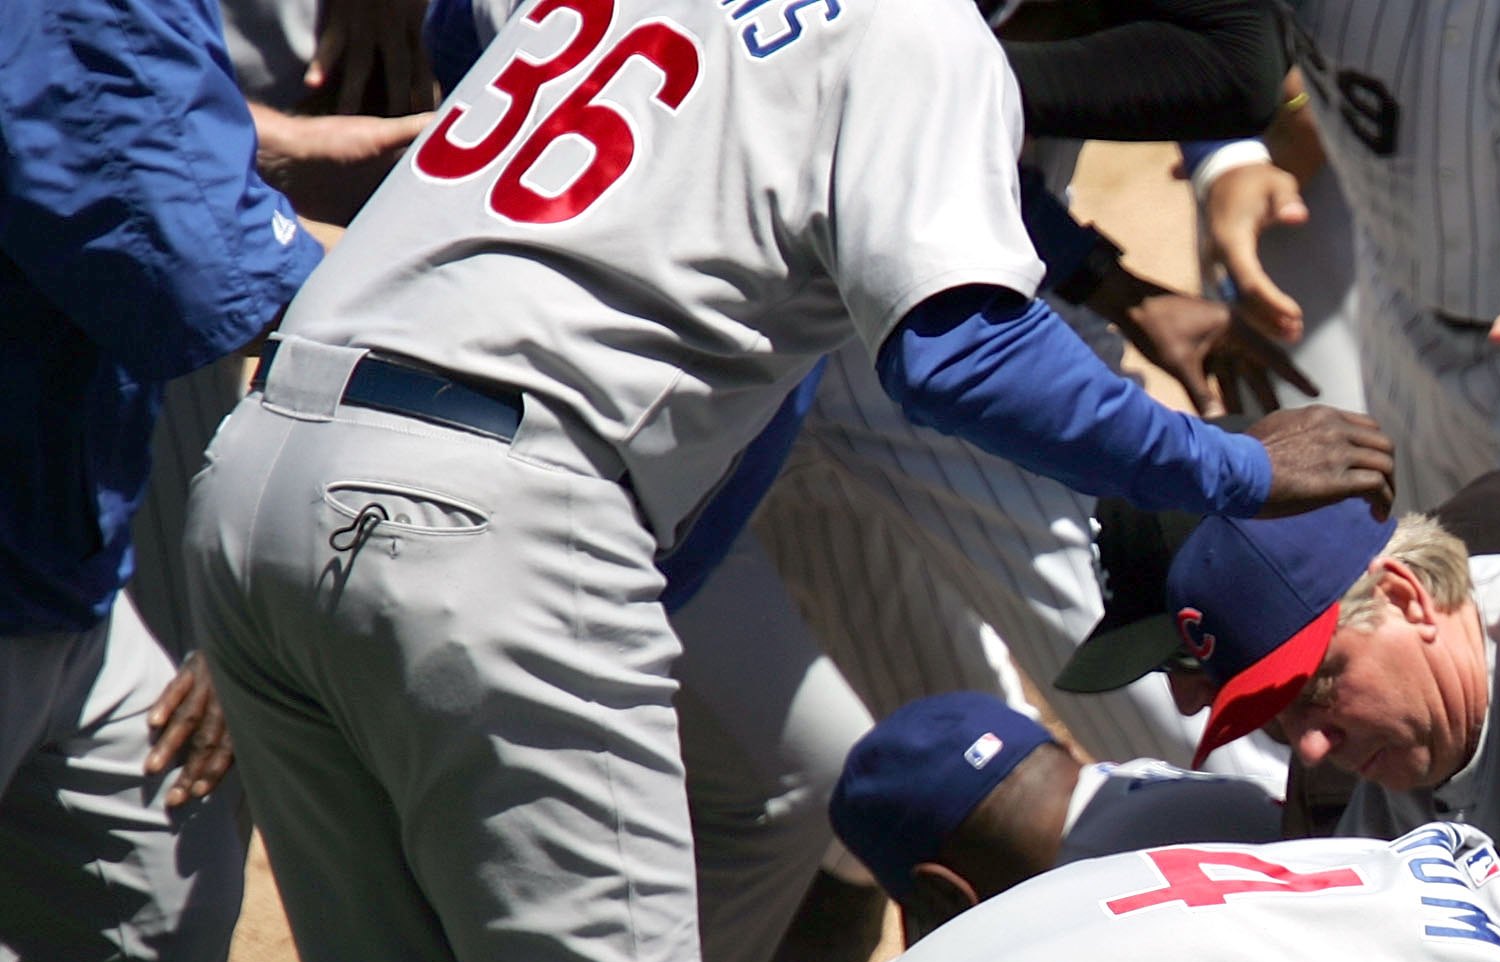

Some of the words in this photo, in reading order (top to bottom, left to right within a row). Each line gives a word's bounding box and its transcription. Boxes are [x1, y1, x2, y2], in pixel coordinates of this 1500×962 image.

[412, 0, 704, 228] 36
[1177, 607, 1215, 660] C
[1100, 846, 1368, 917] 4
